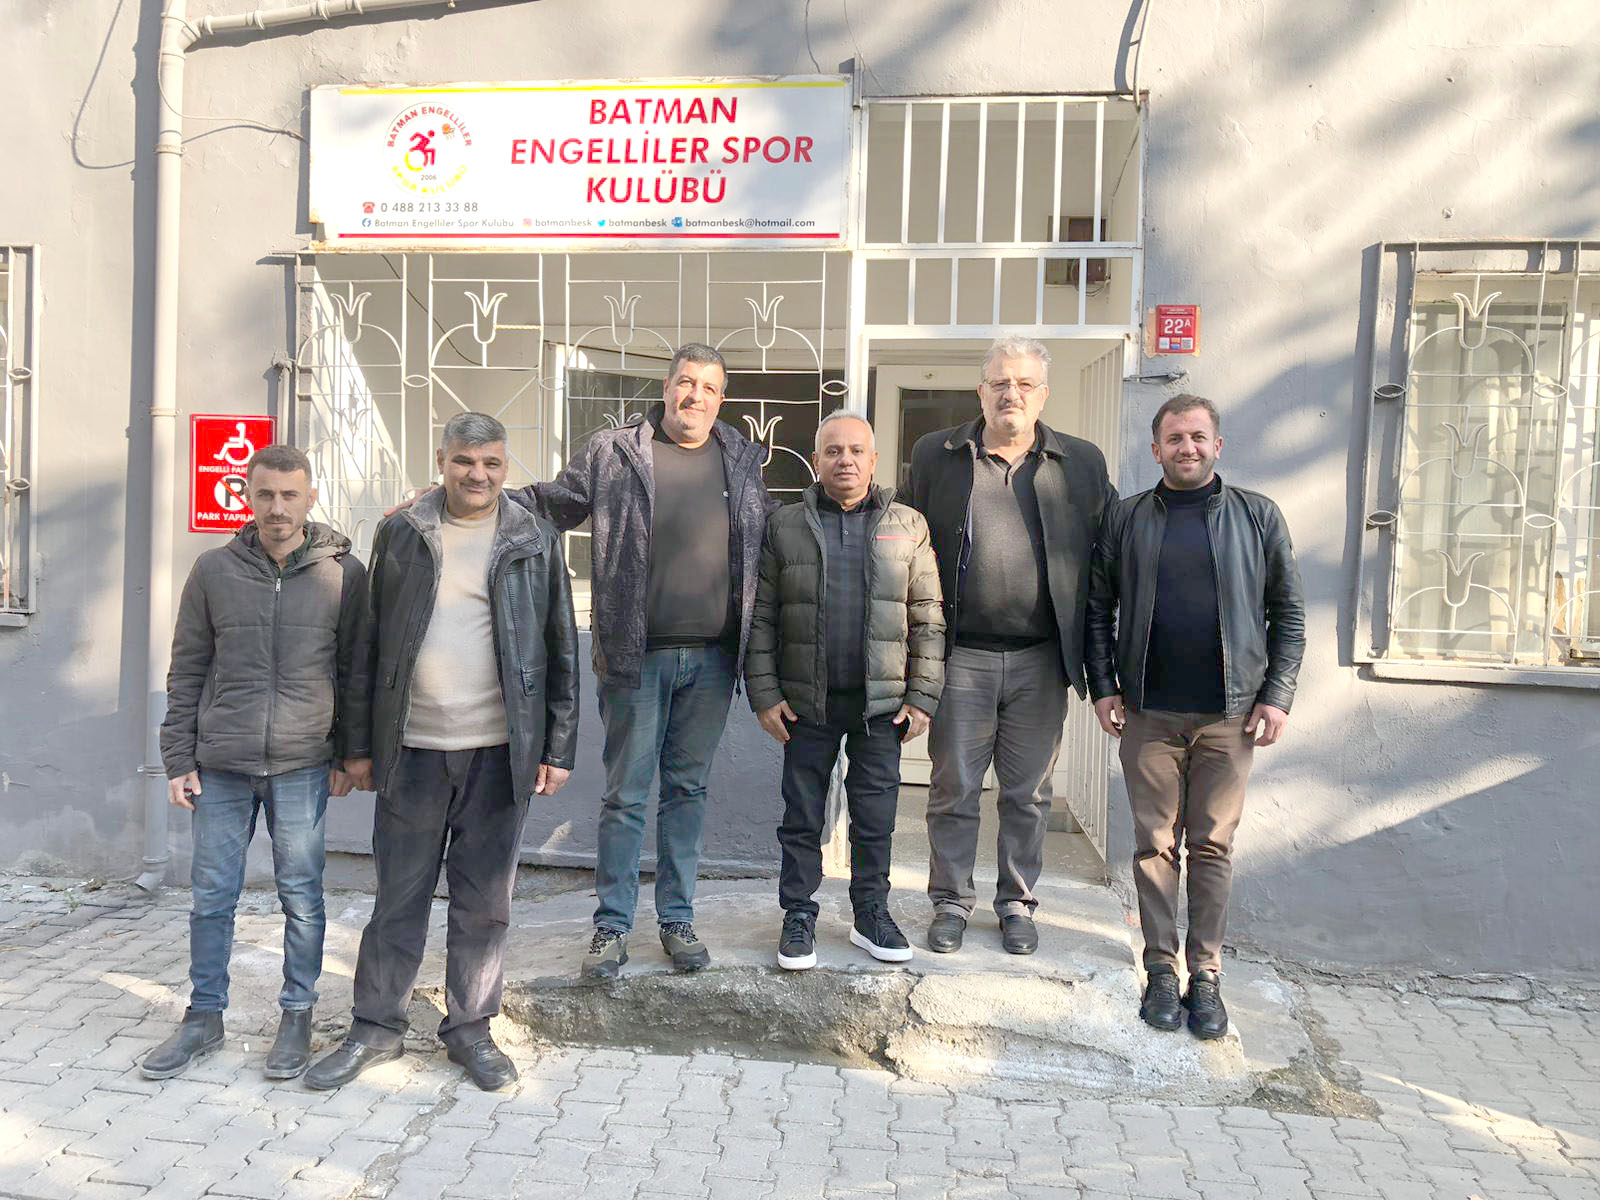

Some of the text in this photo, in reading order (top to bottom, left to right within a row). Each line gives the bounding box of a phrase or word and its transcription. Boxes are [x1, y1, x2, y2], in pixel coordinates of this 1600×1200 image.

[589, 97, 737, 125] BATMAN
[387, 109, 418, 148] BATMAN
[511, 130, 814, 165] ENGELLİLER SPOR
[586, 169, 727, 204] KULÜBÜ
[380, 202, 479, 213] 0 488 213 33 88
[374, 219, 409, 228] Batman
[458, 219, 479, 230] Spor
[535, 218, 593, 228] batmanbesk
[608, 218, 668, 228] batmanbesk
[685, 217, 816, 229] batmanbesk@hotmail.com
[197, 512, 221, 521] PARK
